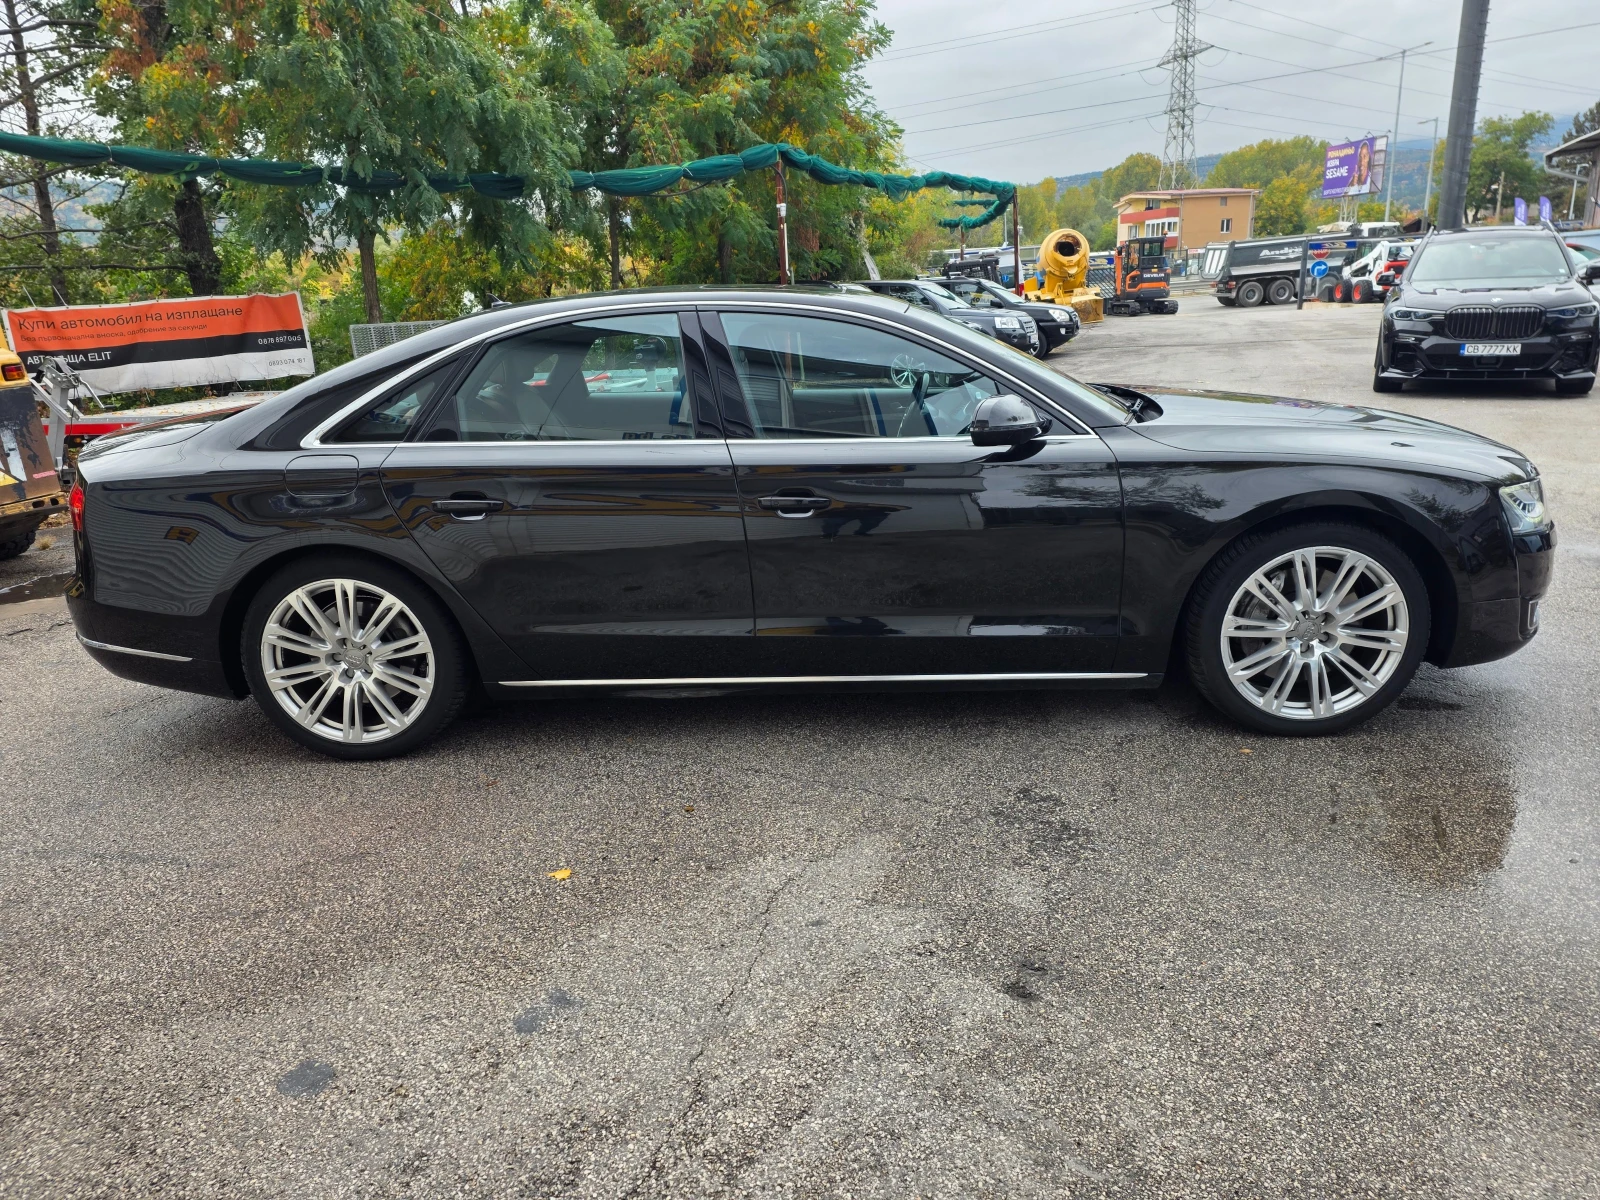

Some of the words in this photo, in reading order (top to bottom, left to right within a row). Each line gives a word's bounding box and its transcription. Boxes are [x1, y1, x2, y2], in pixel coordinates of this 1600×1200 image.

[1325, 166, 1348, 179] SESAME
[18, 317, 56, 332] Купи
[60, 314, 142, 330] автомобил
[145, 312, 162, 321] на
[166, 307, 243, 320] изплащане
[178, 324, 208, 332] секунди
[88, 351, 112, 361] ELIT
